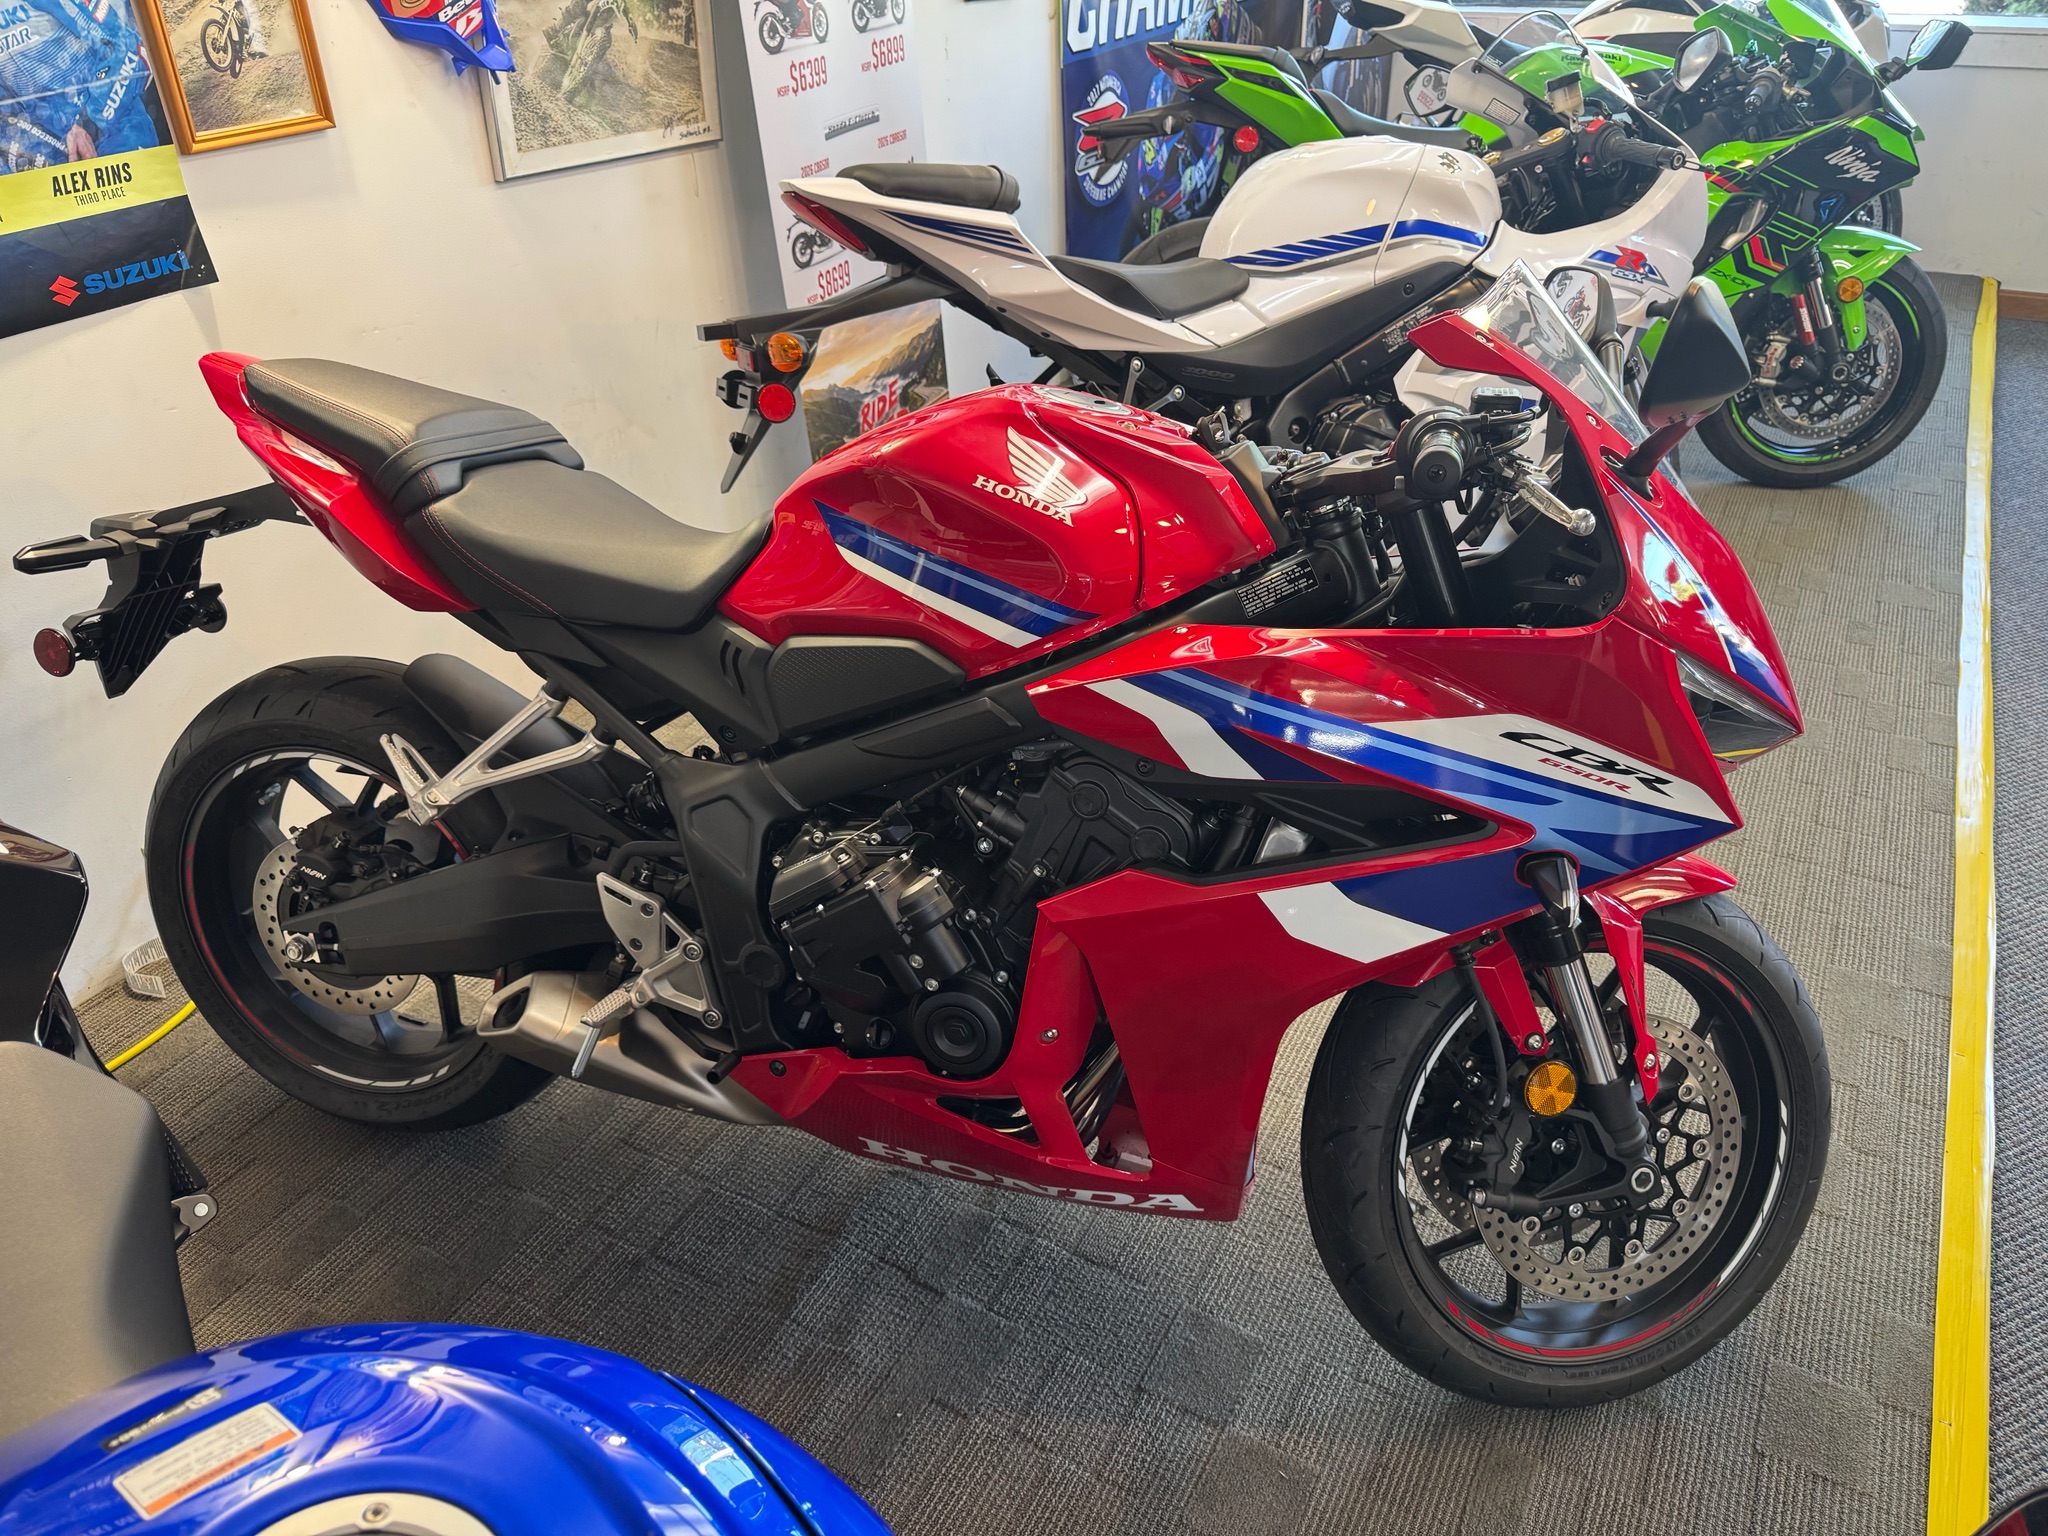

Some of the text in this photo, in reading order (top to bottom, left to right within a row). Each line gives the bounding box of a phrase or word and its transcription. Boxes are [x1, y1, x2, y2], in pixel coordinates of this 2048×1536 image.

[871, 34, 905, 72] $6899
[102, 51, 139, 120] SUZUKI
[790, 56, 828, 97] $6399
[52, 162, 132, 197] ALEX RINS
[1824, 146, 1882, 182] Ninja
[74, 186, 126, 206] THIRD PLACE
[83, 250, 190, 295] SUZUKI
[817, 260, 851, 302] $8699
[1611, 267, 1646, 284] GSX
[861, 378, 900, 434] RIDE
[972, 474, 1074, 527] HONDA
[1498, 731, 1675, 799] CBR
[1537, 757, 1632, 795] 650R
[857, 1136, 1205, 1213] HONDA
